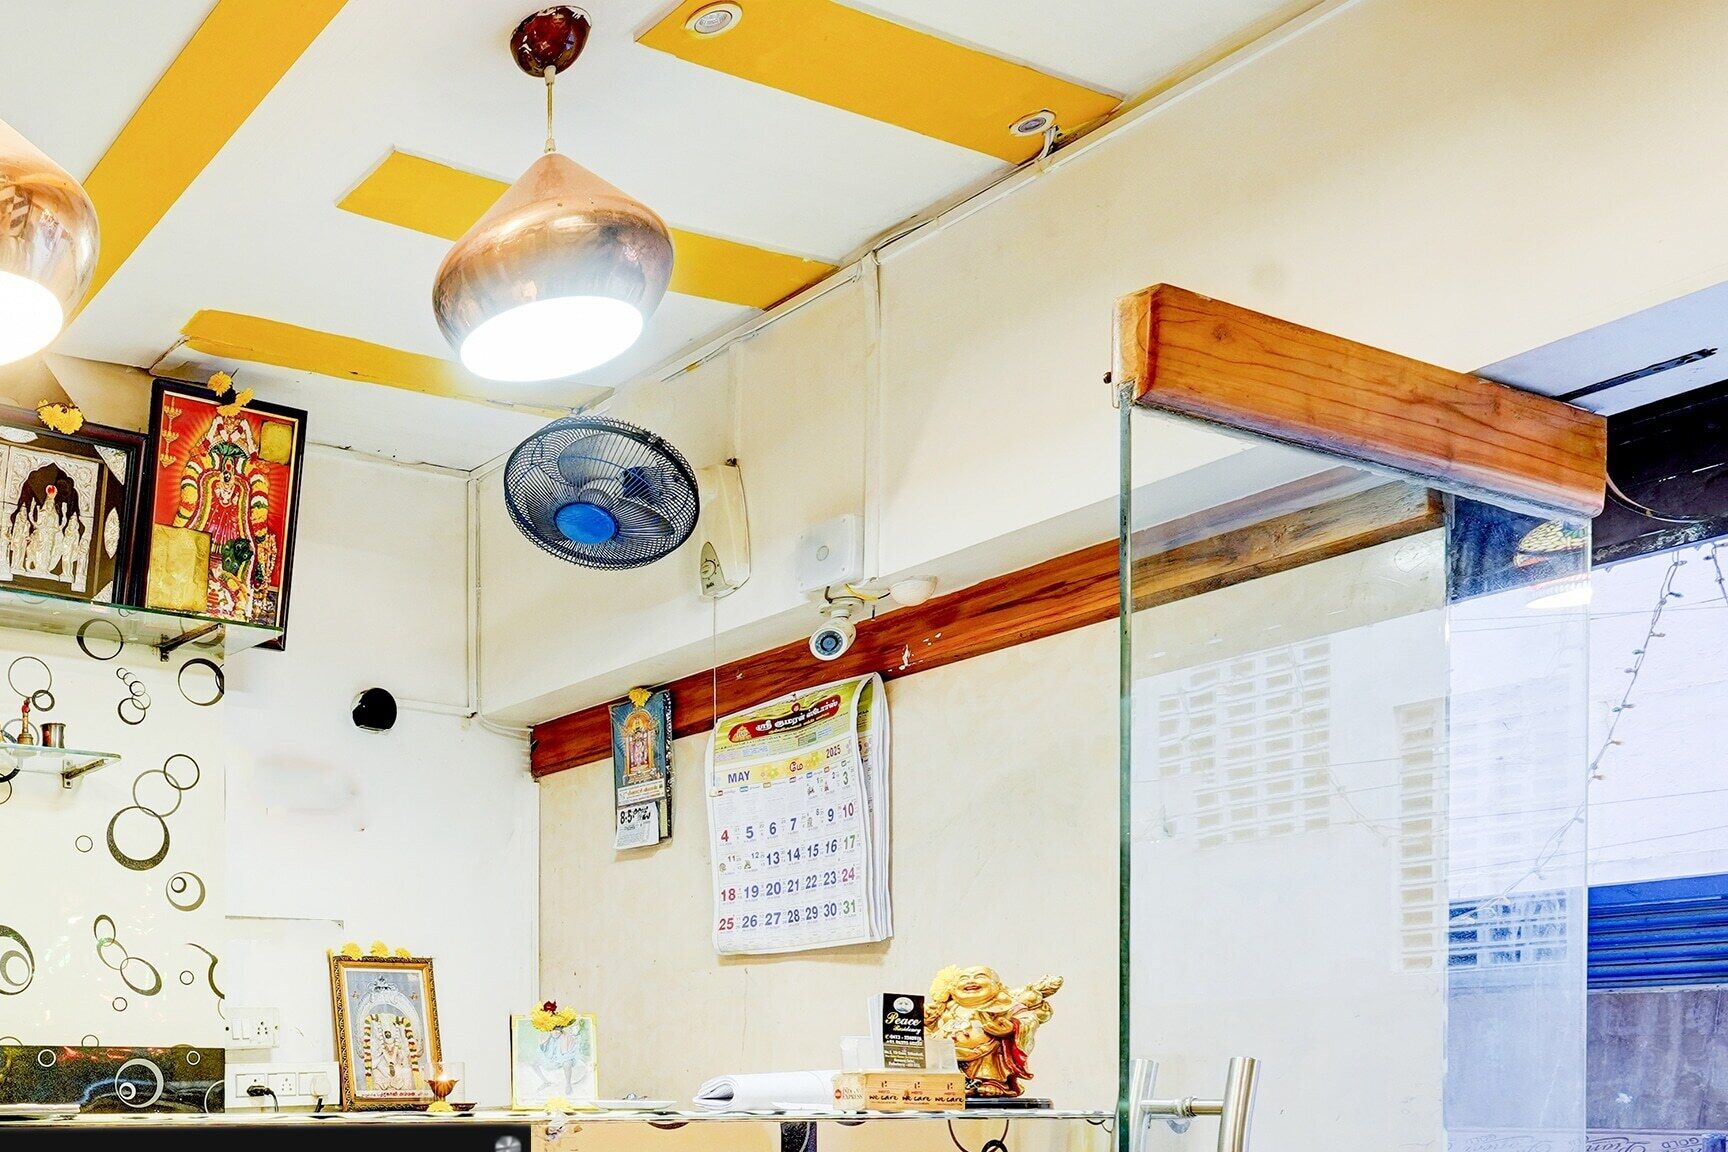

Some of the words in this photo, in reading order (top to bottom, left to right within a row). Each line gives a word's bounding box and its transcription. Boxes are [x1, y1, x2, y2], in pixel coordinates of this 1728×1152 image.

[825, 745, 841, 758] 2025
[727, 771, 750, 783] MAY
[842, 771, 849, 785] 3
[720, 830, 729, 842] 4
[745, 826, 754, 839] 5
[769, 821, 777, 835] 6
[790, 817, 797, 831] 7
[827, 808, 834, 822] 9
[842, 803, 854, 818] 10
[766, 851, 780, 865] 13
[787, 848, 801, 861] 14
[807, 844, 819, 858] 15
[825, 839, 838, 853] 16
[843, 835, 855, 850] 17
[721, 888, 736, 901] 18
[744, 885, 759, 898] 19
[766, 882, 781, 896] 20
[787, 879, 800, 892] 21
[805, 874, 817, 889] 22
[823, 871, 837, 885] 23
[841, 867, 855, 882] 24
[719, 917, 735, 931] 25
[742, 914, 757, 928] 26
[765, 912, 781, 926] 27
[787, 909, 800, 923] 28
[806, 906, 818, 920] 29
[823, 903, 837, 916] 30
[843, 900, 856, 914] 31
[885, 1012, 921, 1026] Peace
[1662, 1137, 1699, 1149] GOLD
